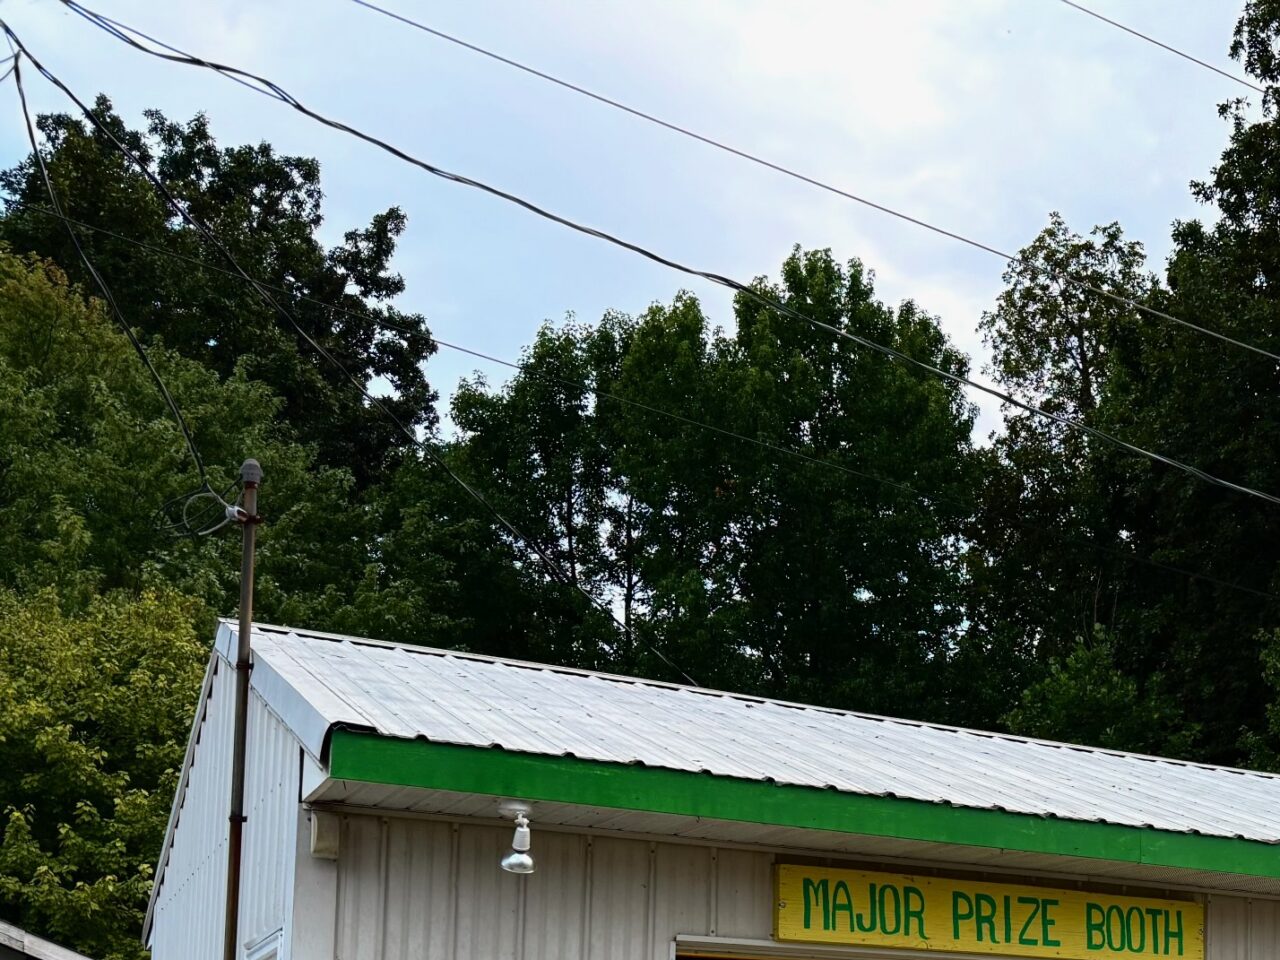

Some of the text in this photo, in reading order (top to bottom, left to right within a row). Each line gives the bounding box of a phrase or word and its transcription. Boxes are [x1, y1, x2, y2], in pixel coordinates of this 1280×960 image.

[802, 878, 1184, 956] MAJOR PRIZE BOOTH
